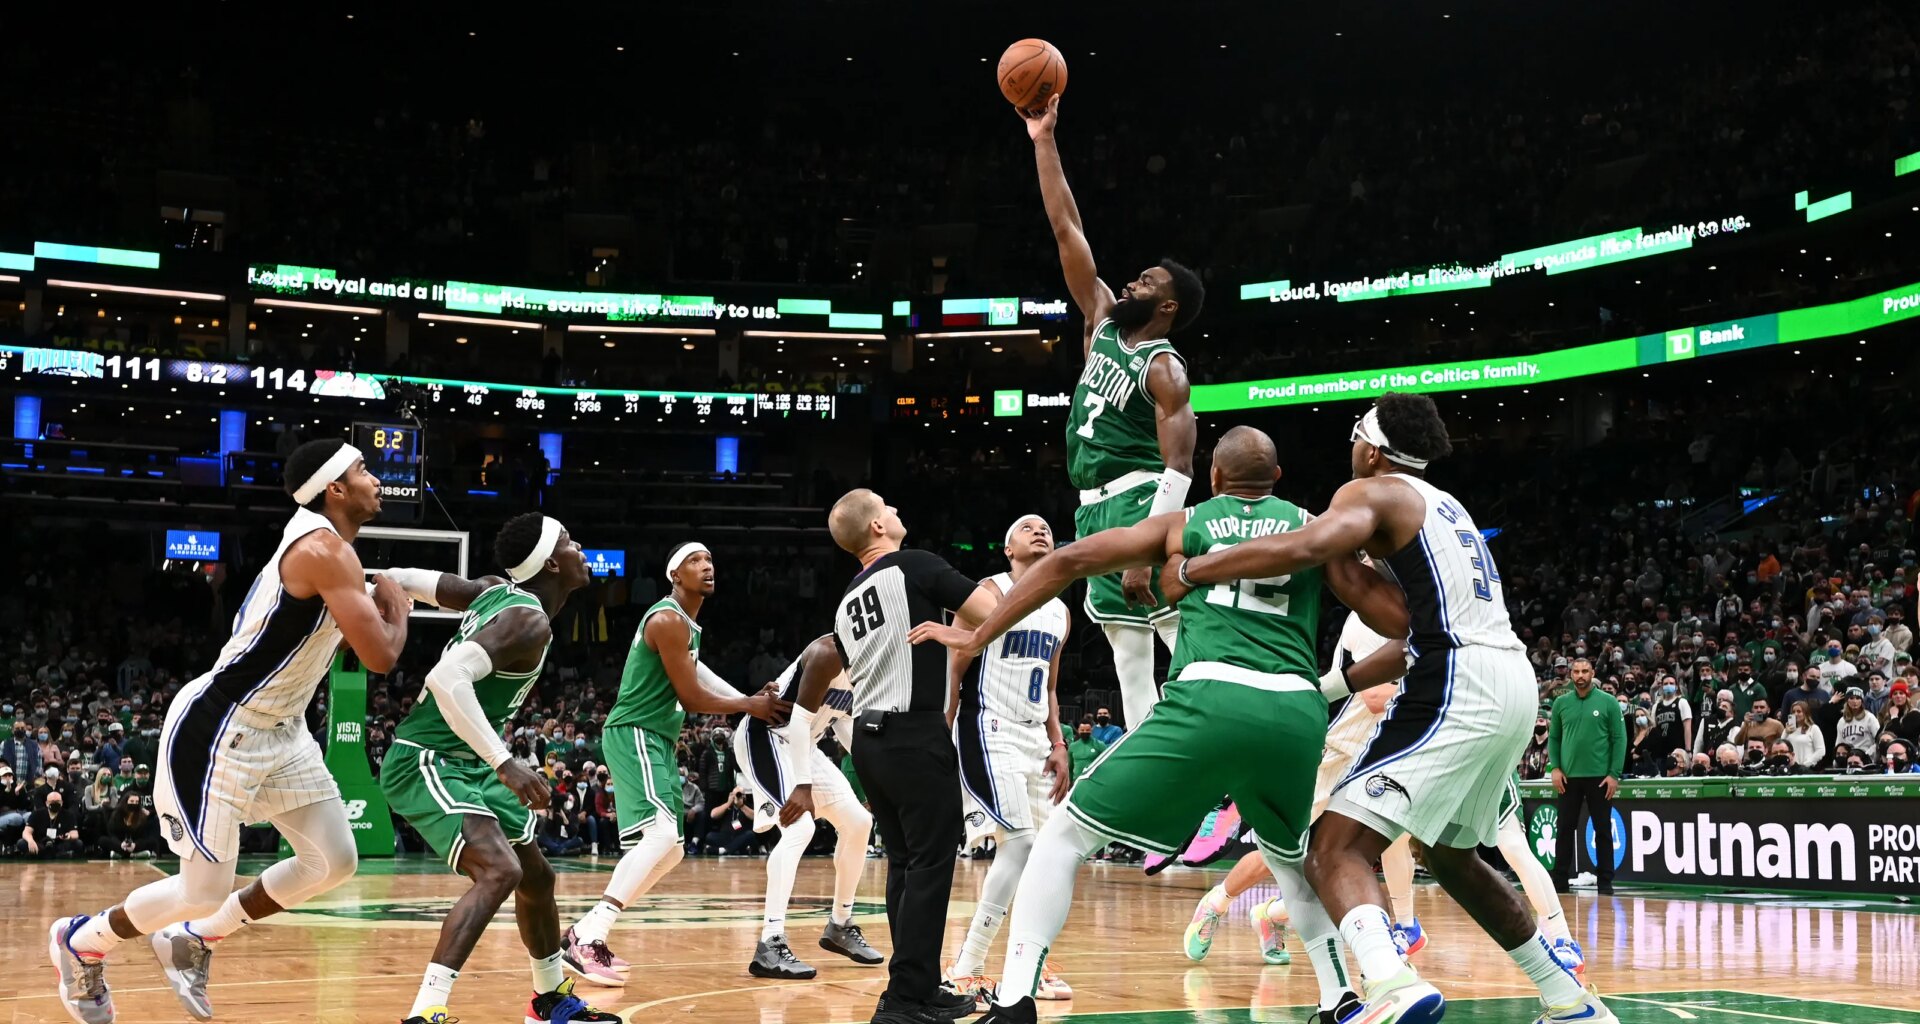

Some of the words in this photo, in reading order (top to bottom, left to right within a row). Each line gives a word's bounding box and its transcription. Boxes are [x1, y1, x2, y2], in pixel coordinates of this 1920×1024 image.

[1270, 282, 1321, 302] Loud,
[1323, 278, 1369, 297] loyal
[1372, 272, 1410, 291] and
[1412, 274, 1426, 286] a
[1534, 244, 1597, 270] sounds
[1600, 238, 1632, 257] like
[1636, 224, 1695, 250] family
[1697, 221, 1718, 238] to
[314, 273, 366, 295] loyal
[369, 281, 410, 298] and
[414, 285, 428, 299] a
[432, 285, 479, 304] little
[547, 298, 618, 315] sounds
[623, 299, 656, 316] like
[662, 300, 722, 320] family
[728, 304, 749, 318] to
[752, 306, 781, 319] us.
[1883, 293, 1920, 314] Prou
[1700, 325, 1744, 345] Bank
[23, 347, 104, 379] MAGIC
[106, 355, 160, 381] 111
[187, 363, 227, 384] 8.2
[250, 366, 307, 392] 114
[1079, 351, 1136, 413] BOSTON
[1248, 383, 1296, 399] Proud
[1299, 380, 1366, 396] member
[1370, 375, 1388, 389] of
[1390, 374, 1417, 387] the
[1420, 368, 1480, 384] Celtics
[1483, 362, 1540, 379] family.
[625, 402, 637, 413] 21
[730, 405, 744, 416] 44
[997, 395, 1020, 411] TD
[1027, 393, 1070, 407] Bank
[1076, 391, 1105, 439] 7
[374, 429, 403, 449] 8.2
[379, 486, 418, 497] ISSOT
[1205, 514, 1291, 539] HORFORD
[169, 543, 216, 552] ARBELLA
[846, 585, 885, 641] 39
[1000, 630, 1061, 662] MAGI
[1028, 666, 1044, 703] 8
[336, 722, 361, 734] VISTA
[336, 733, 361, 743] PRINT
[350, 822, 373, 830] ance
[1531, 807, 1558, 834] CELTIC
[1631, 810, 1857, 881] Putnam
